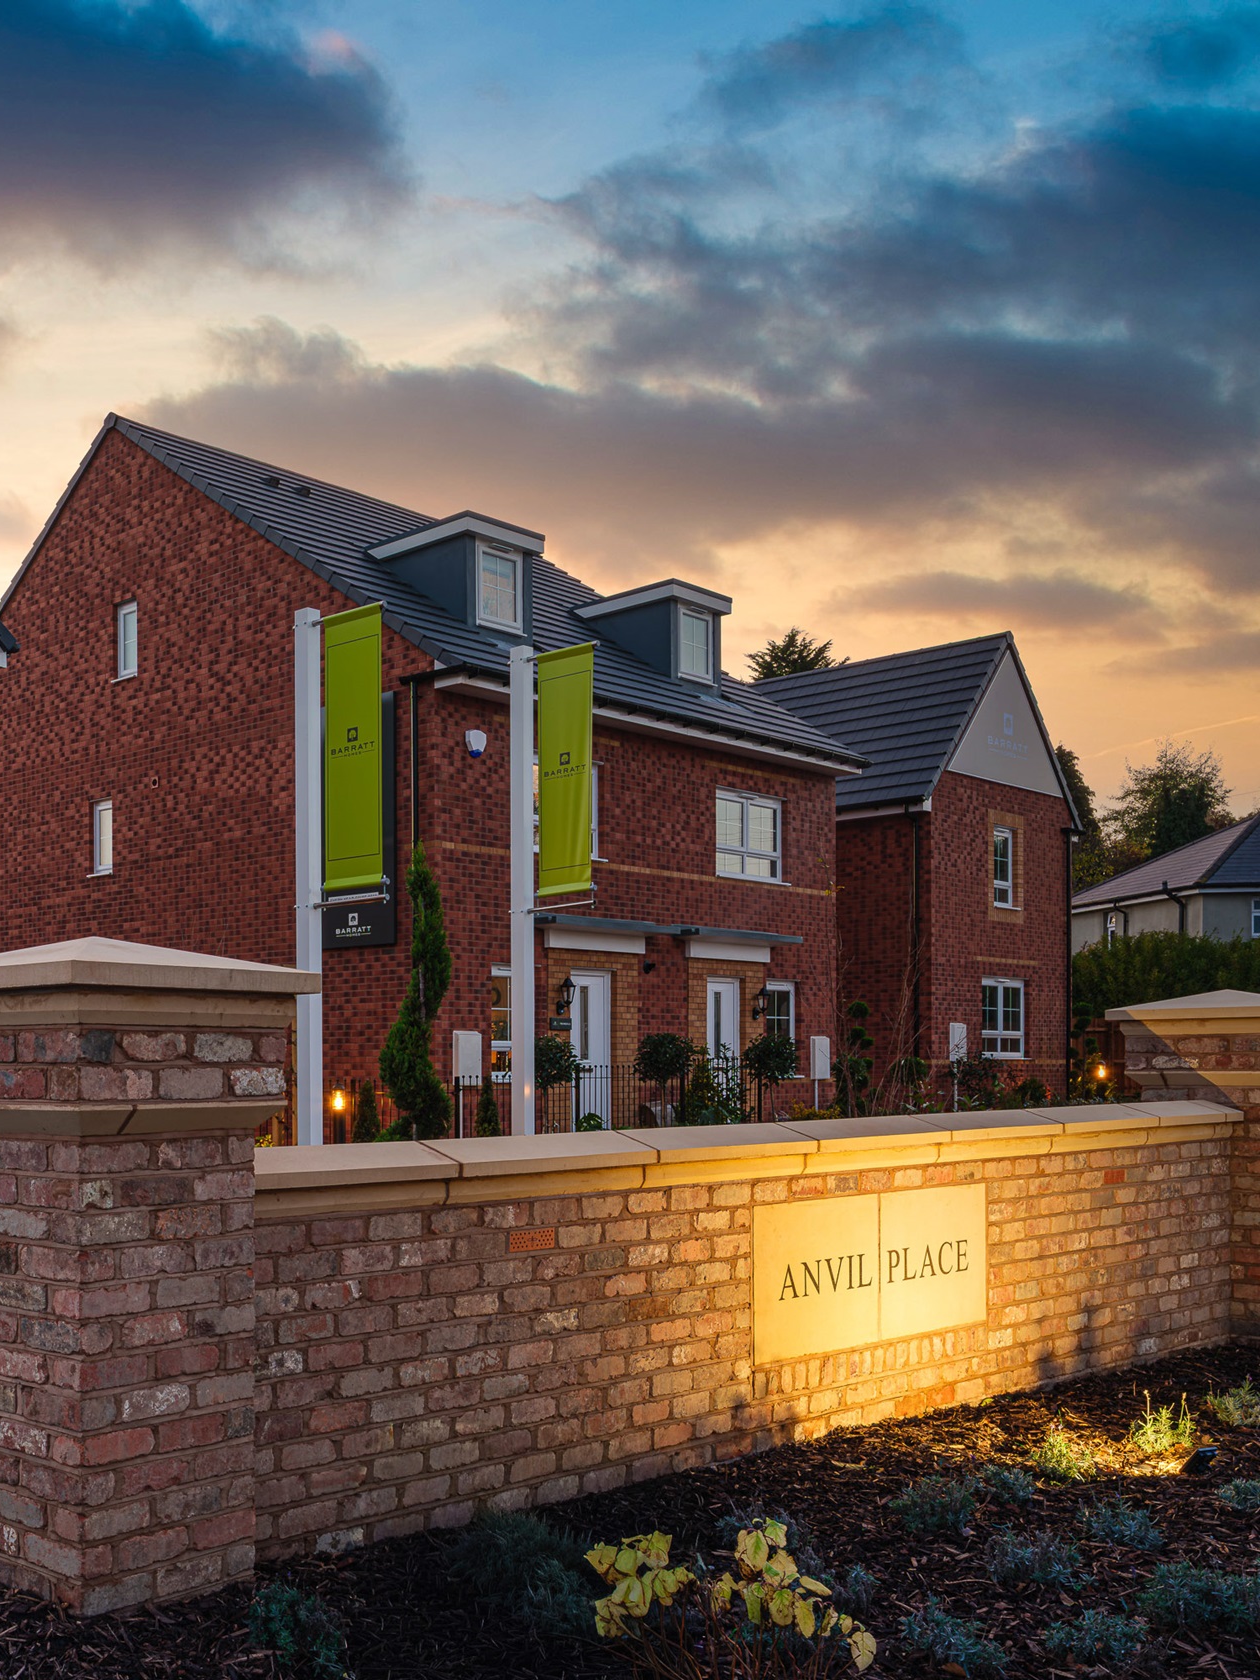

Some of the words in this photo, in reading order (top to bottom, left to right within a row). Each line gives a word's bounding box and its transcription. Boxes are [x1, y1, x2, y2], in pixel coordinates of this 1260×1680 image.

[330, 741, 375, 756] BARRATT
[987, 735, 1028, 754] BARRATT
[543, 764, 586, 778] BARRATT
[335, 925, 371, 935] BARRATT
[778, 1253, 873, 1302] ANVIL
[886, 1239, 970, 1284] PLACE
